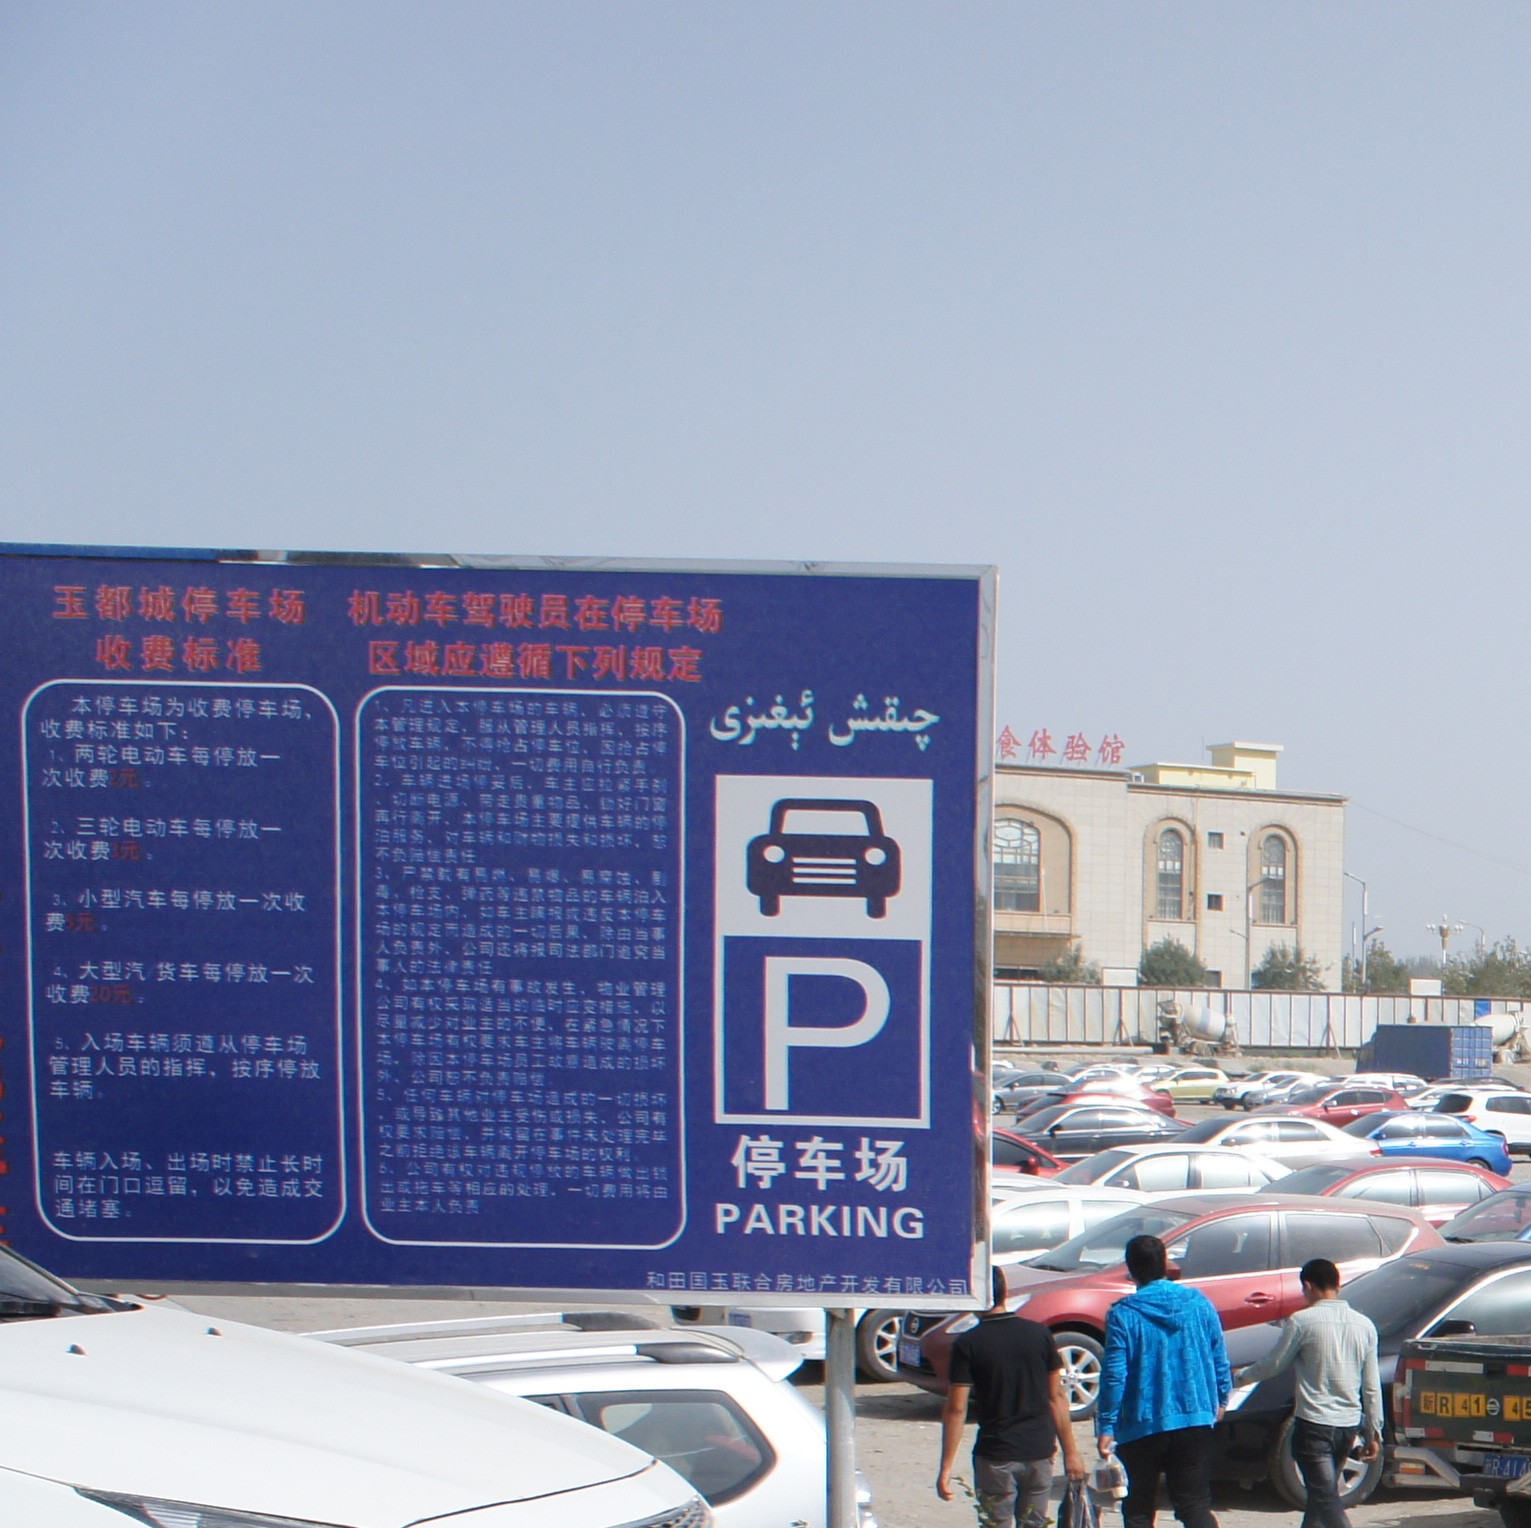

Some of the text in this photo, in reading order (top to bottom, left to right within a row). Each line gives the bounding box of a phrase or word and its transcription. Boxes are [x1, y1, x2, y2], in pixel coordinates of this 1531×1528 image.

[53, 584, 307, 624] 玉都城停车场
[348, 589, 724, 633] 机动车驾驶员在停车场
[95, 634, 264, 674] 收费标准
[368, 640, 704, 683] 区域应遵循下列规定
[996, 724, 1126, 763] 食体验馆
[763, 956, 891, 1111] P
[731, 1134, 908, 1192] 停车场
[715, 1202, 925, 1240] PARKING
[646, 1270, 968, 1296] 和田国玉联合房地产开发有限公司
